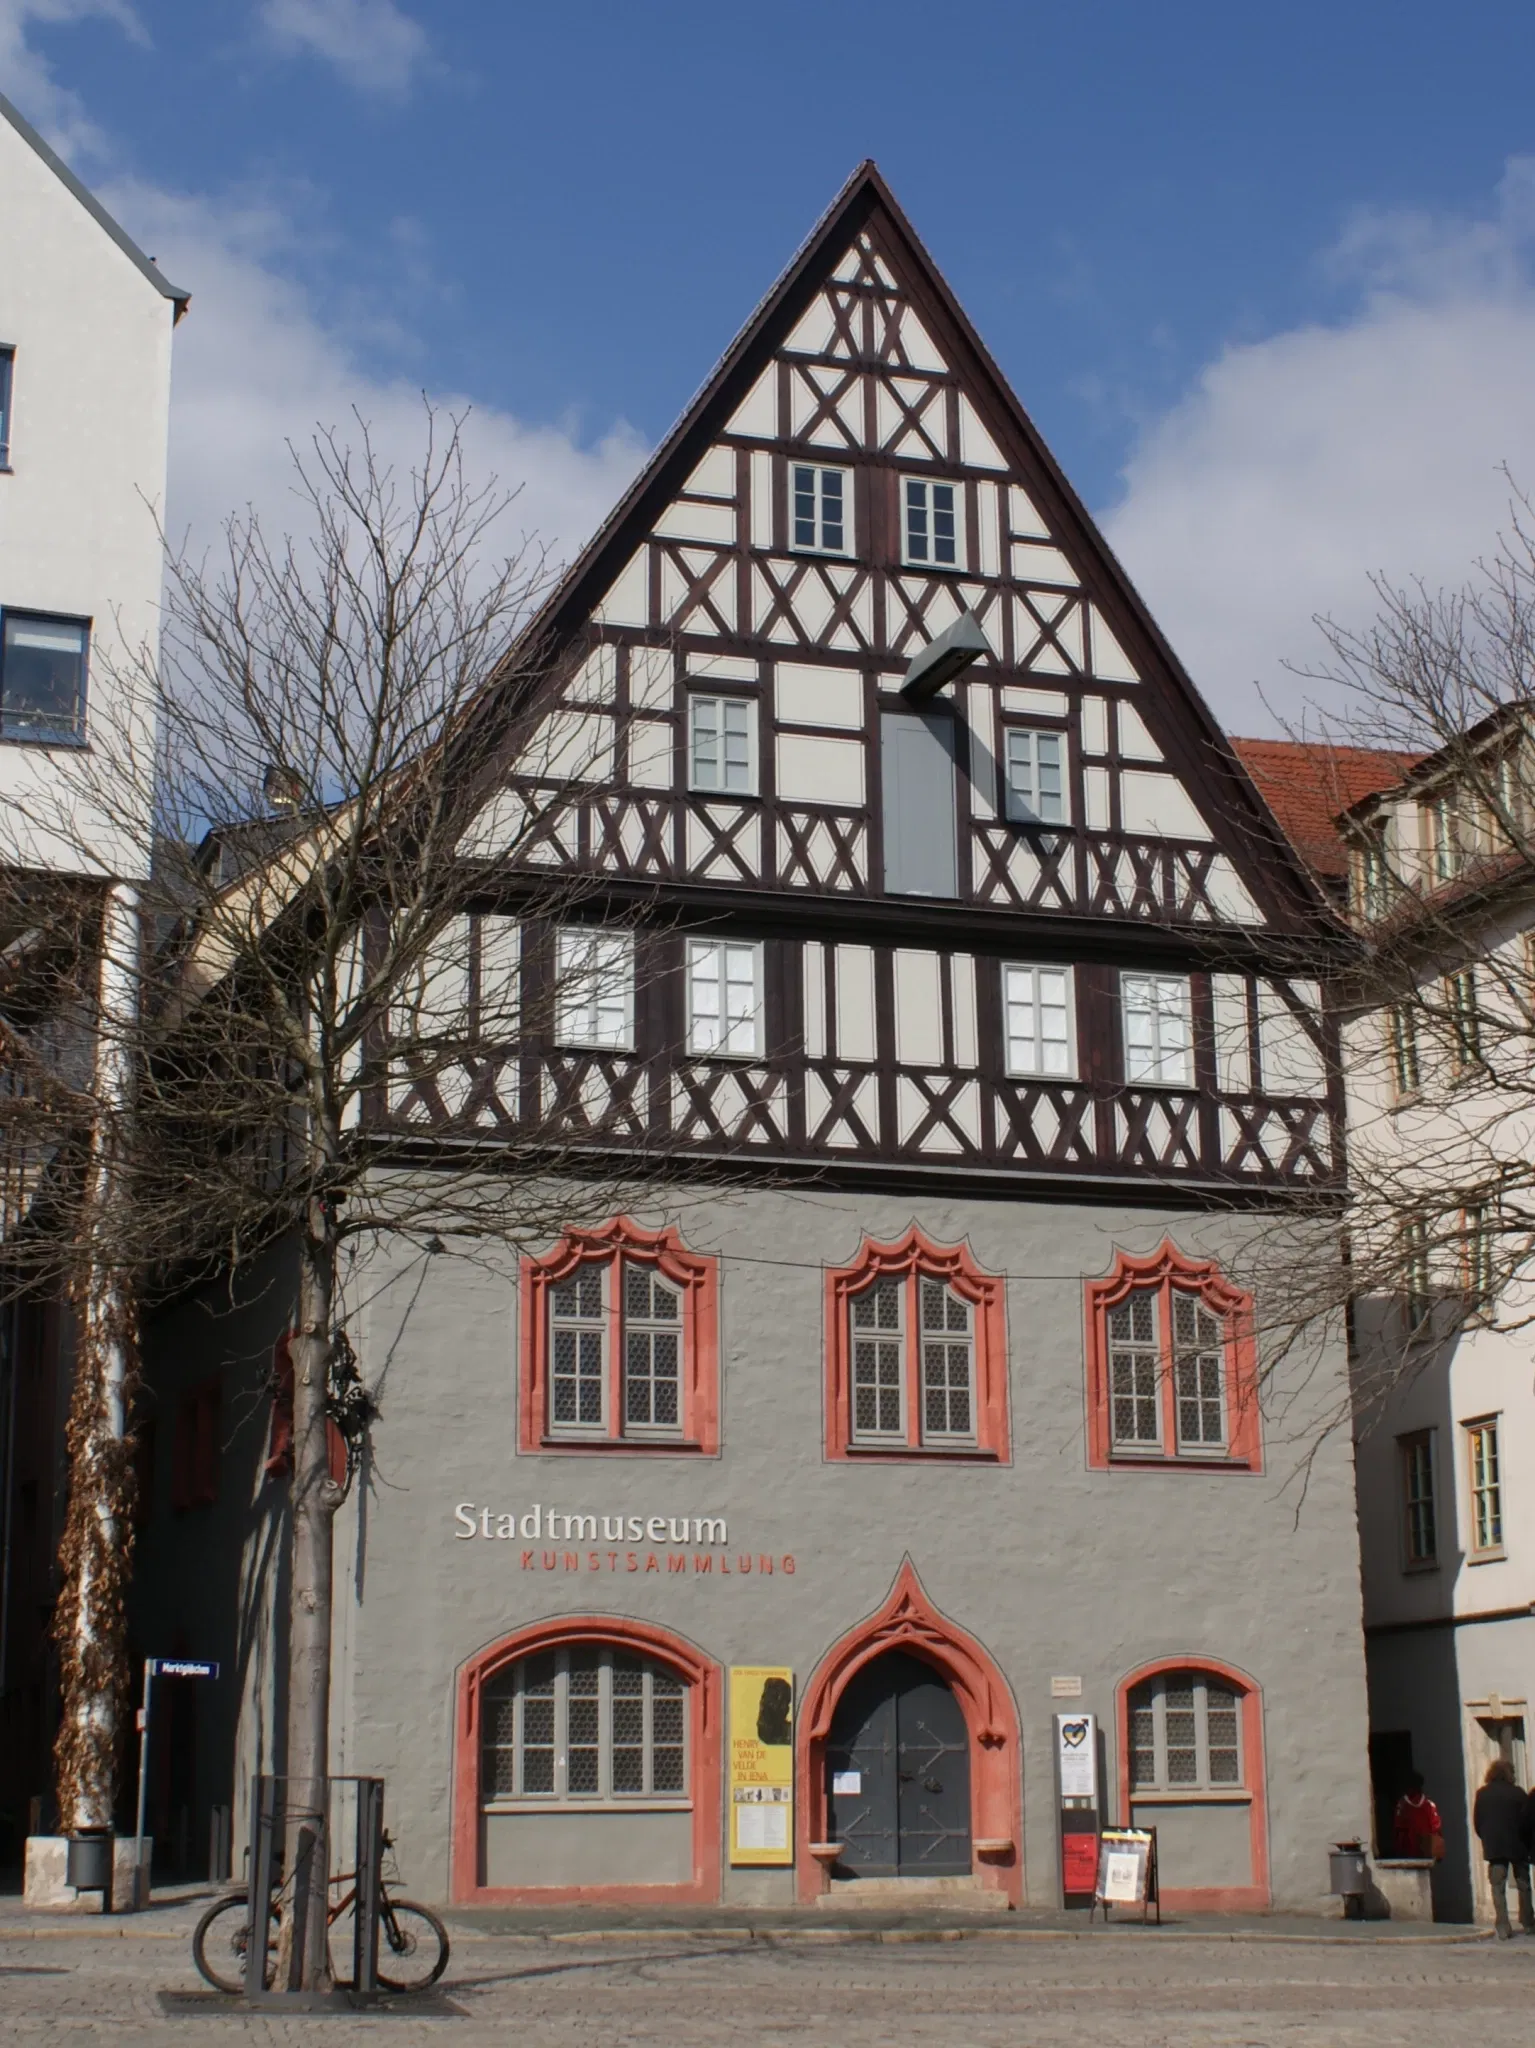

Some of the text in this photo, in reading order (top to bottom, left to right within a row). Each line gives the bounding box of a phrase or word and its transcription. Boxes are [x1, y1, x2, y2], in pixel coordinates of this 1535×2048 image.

[454, 1503, 729, 1545] Stadtmuseum
[520, 1551, 796, 1575] KUNSTSAMMLUNG
[733, 1739, 760, 1749] HENRY
[737, 1750, 754, 1760] VAN
